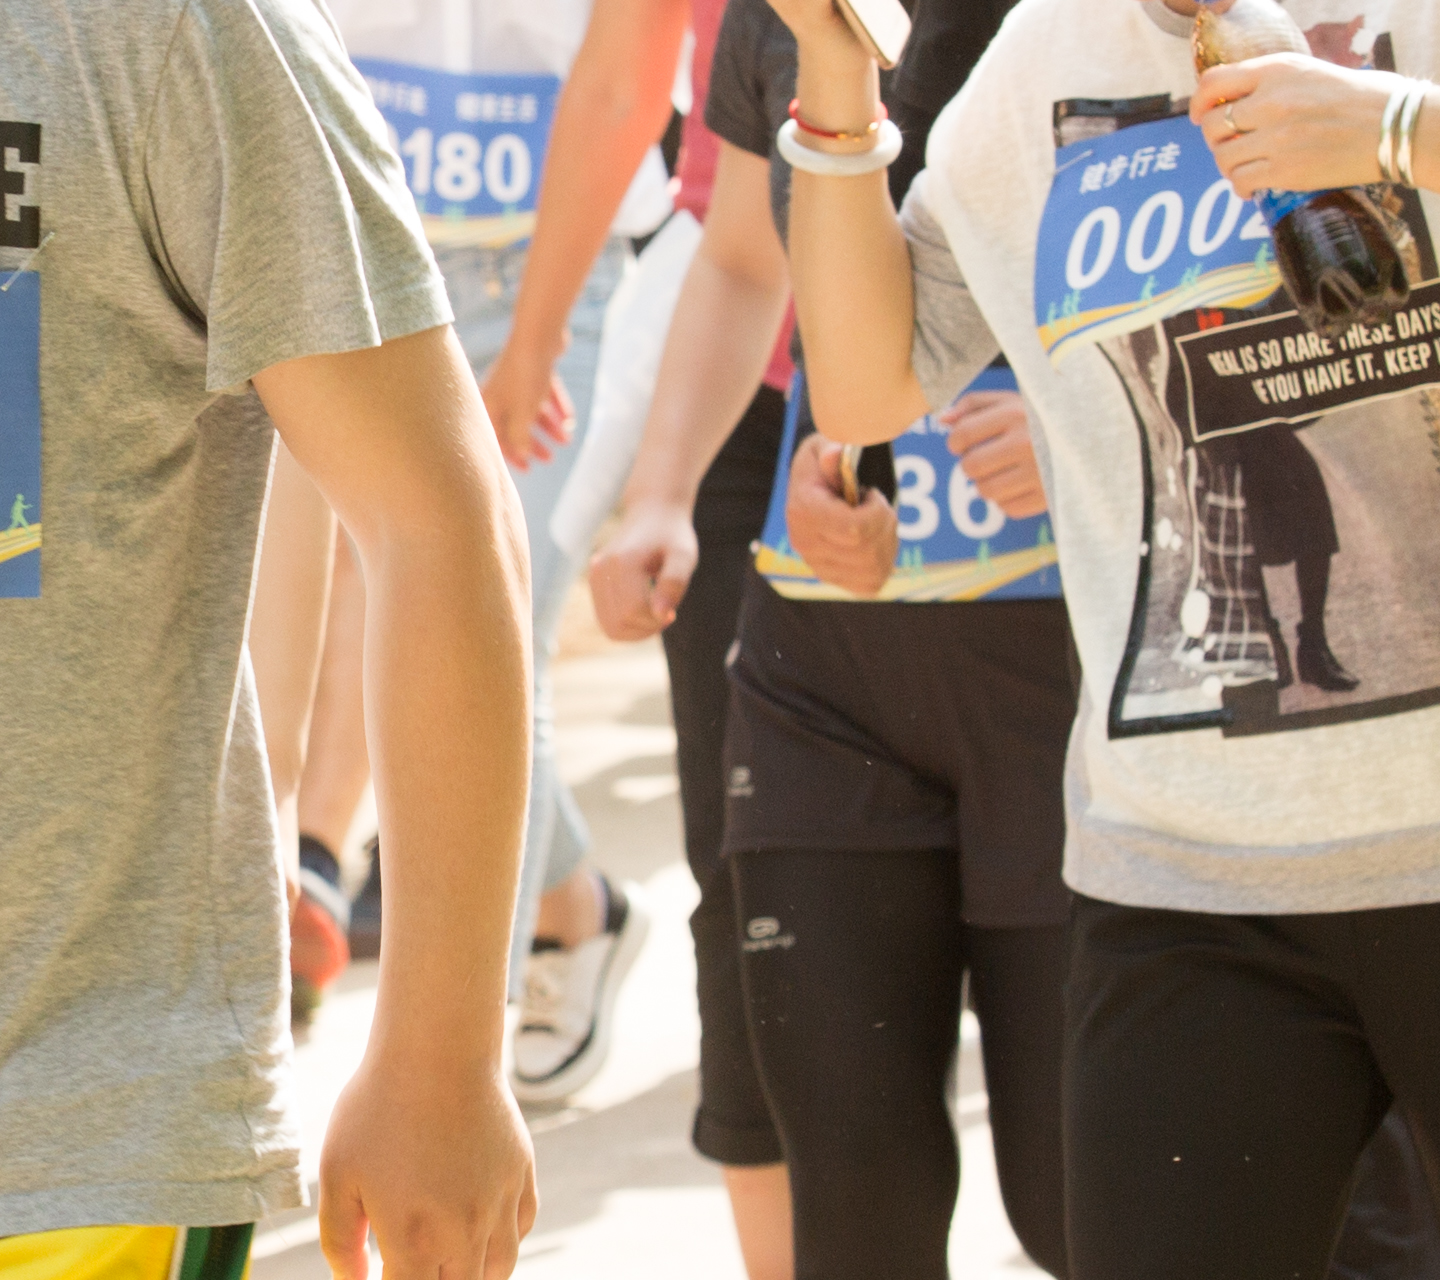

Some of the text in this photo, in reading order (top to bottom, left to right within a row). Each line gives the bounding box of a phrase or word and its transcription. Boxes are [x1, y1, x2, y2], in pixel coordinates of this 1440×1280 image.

[388, 124, 532, 203] 180
[1079, 141, 1181, 195] 健步行走
[1065, 178, 1271, 290] 000
[1239, 345, 1258, 373] IS
[1258, 338, 1283, 370] SO
[1284, 331, 1334, 363] RARE
[1266, 372, 1302, 403] YOU
[1303, 358, 1356, 396] HAVE
[1384, 340, 1432, 377] KEEP
[894, 454, 1007, 540] 36
